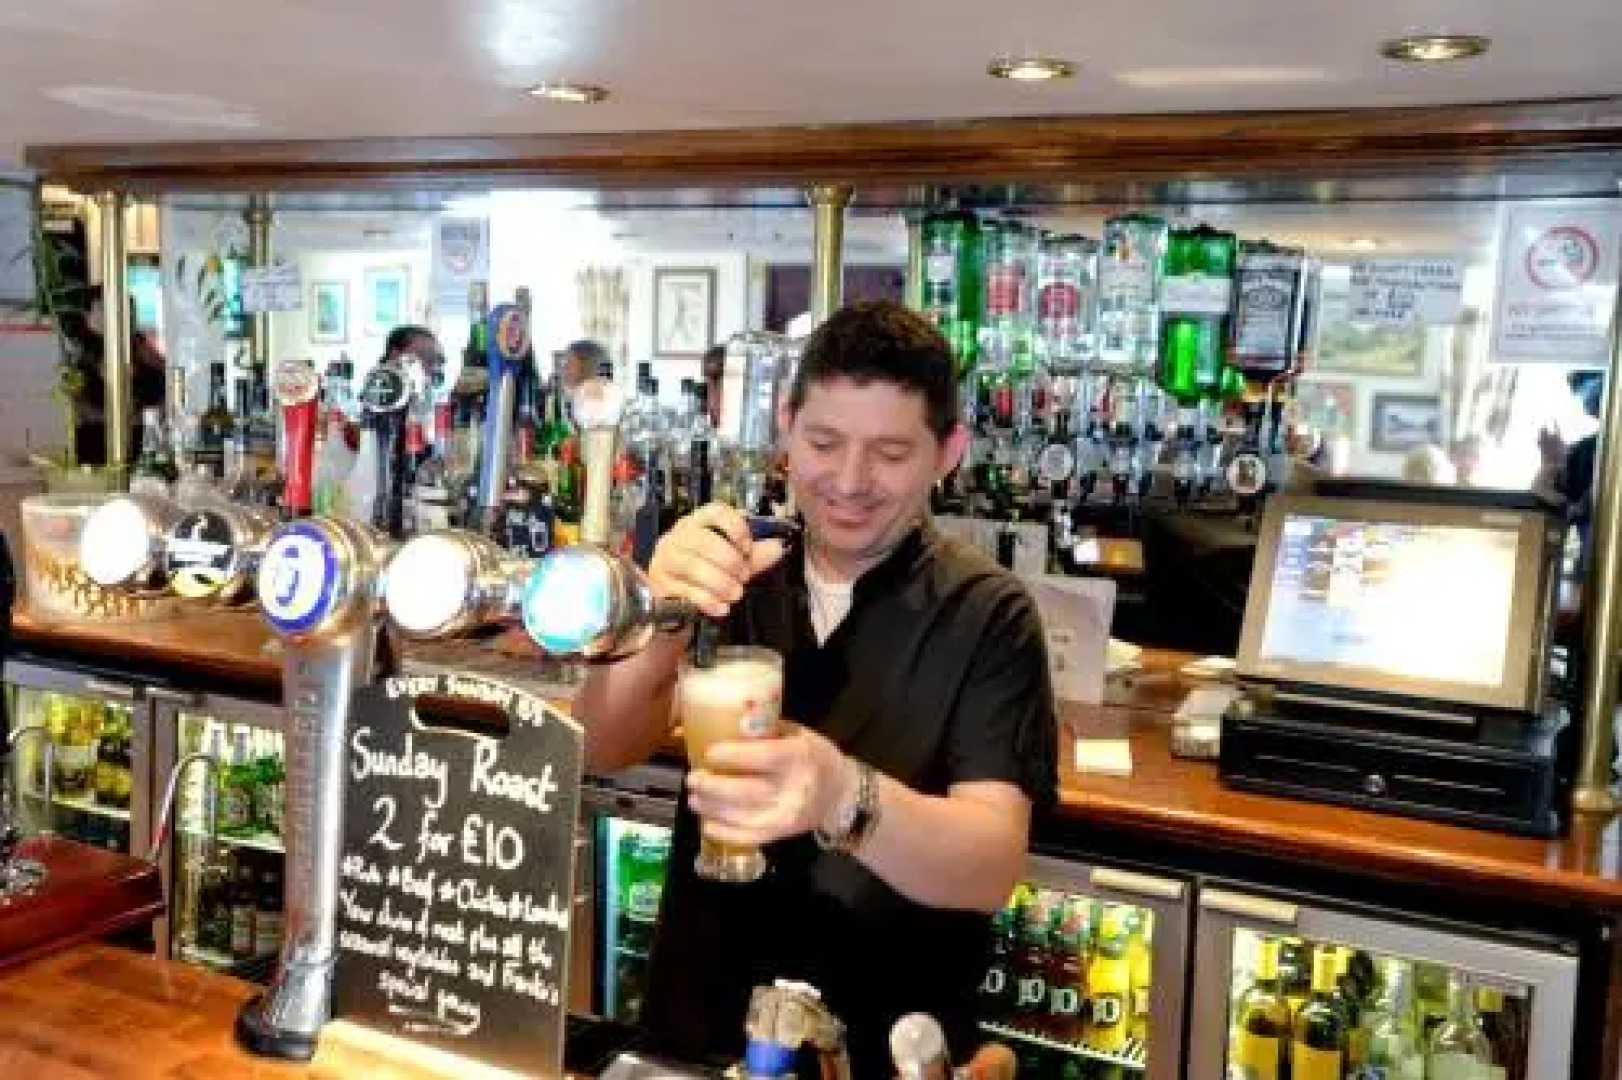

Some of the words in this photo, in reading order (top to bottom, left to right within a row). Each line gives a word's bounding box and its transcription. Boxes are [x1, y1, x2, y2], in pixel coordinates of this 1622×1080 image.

[353, 726, 448, 808] Sunday
[470, 735, 558, 812] Roast
[368, 797, 403, 850] 2
[415, 808, 453, 863] for
[461, 814, 525, 870] £10
